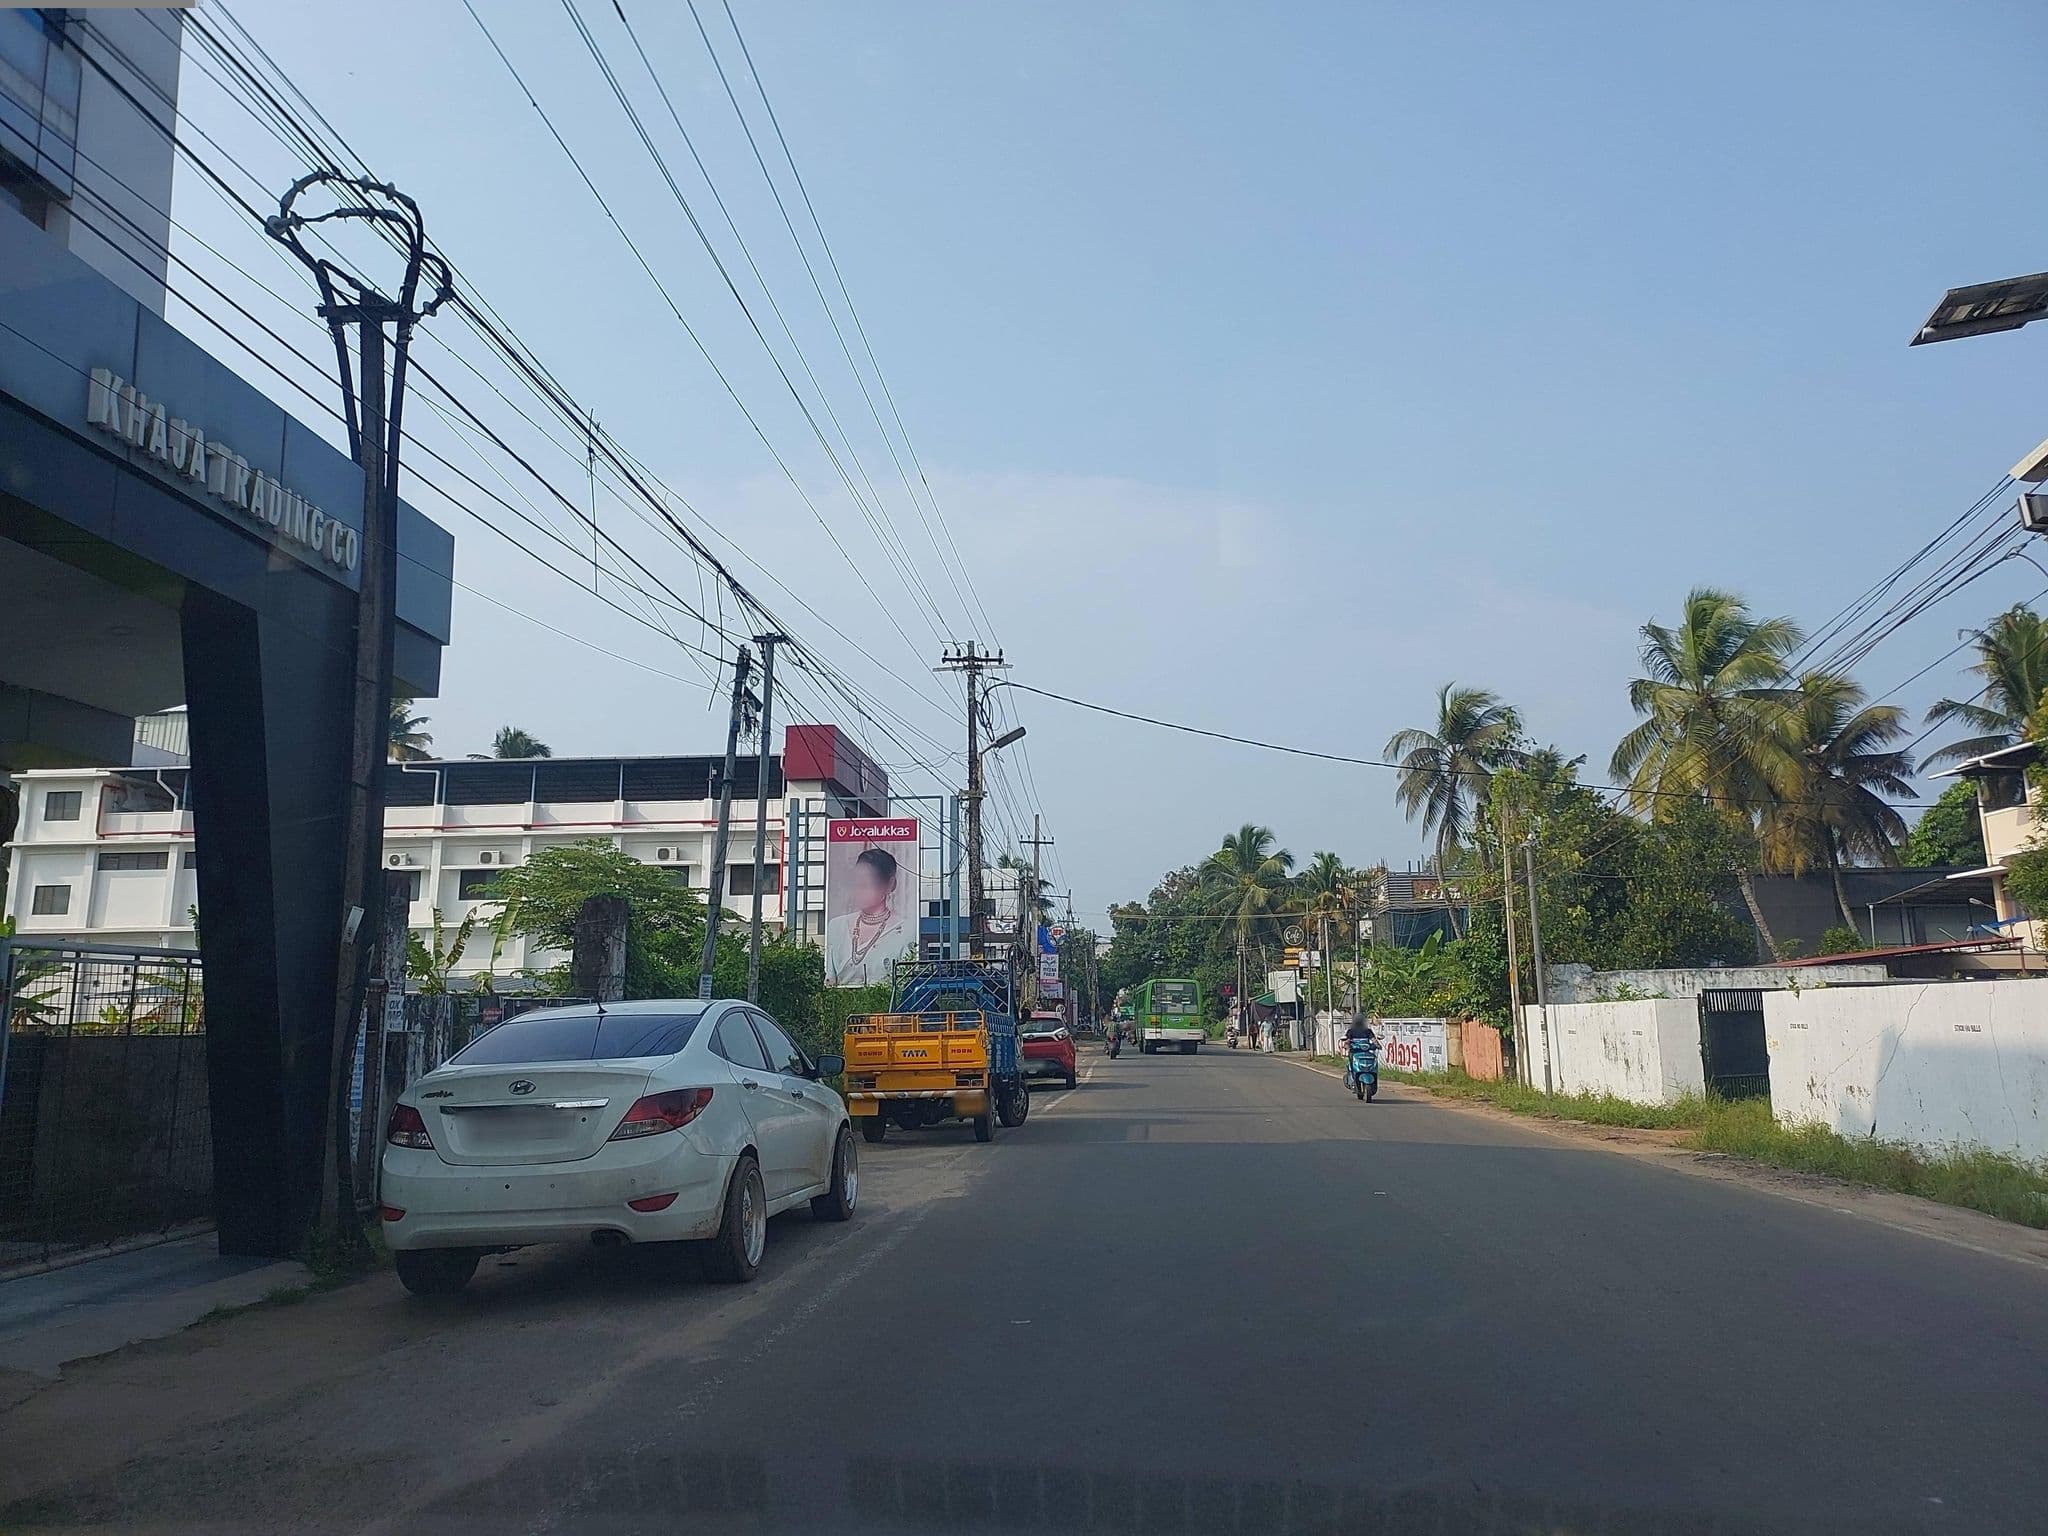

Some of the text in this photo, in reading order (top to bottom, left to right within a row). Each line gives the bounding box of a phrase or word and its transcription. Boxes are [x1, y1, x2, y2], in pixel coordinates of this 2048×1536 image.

[88, 367, 358, 573] KHAJA TRADING CO
[849, 825, 910, 837] Joyalukkas
[901, 1050, 928, 1058] TATA
